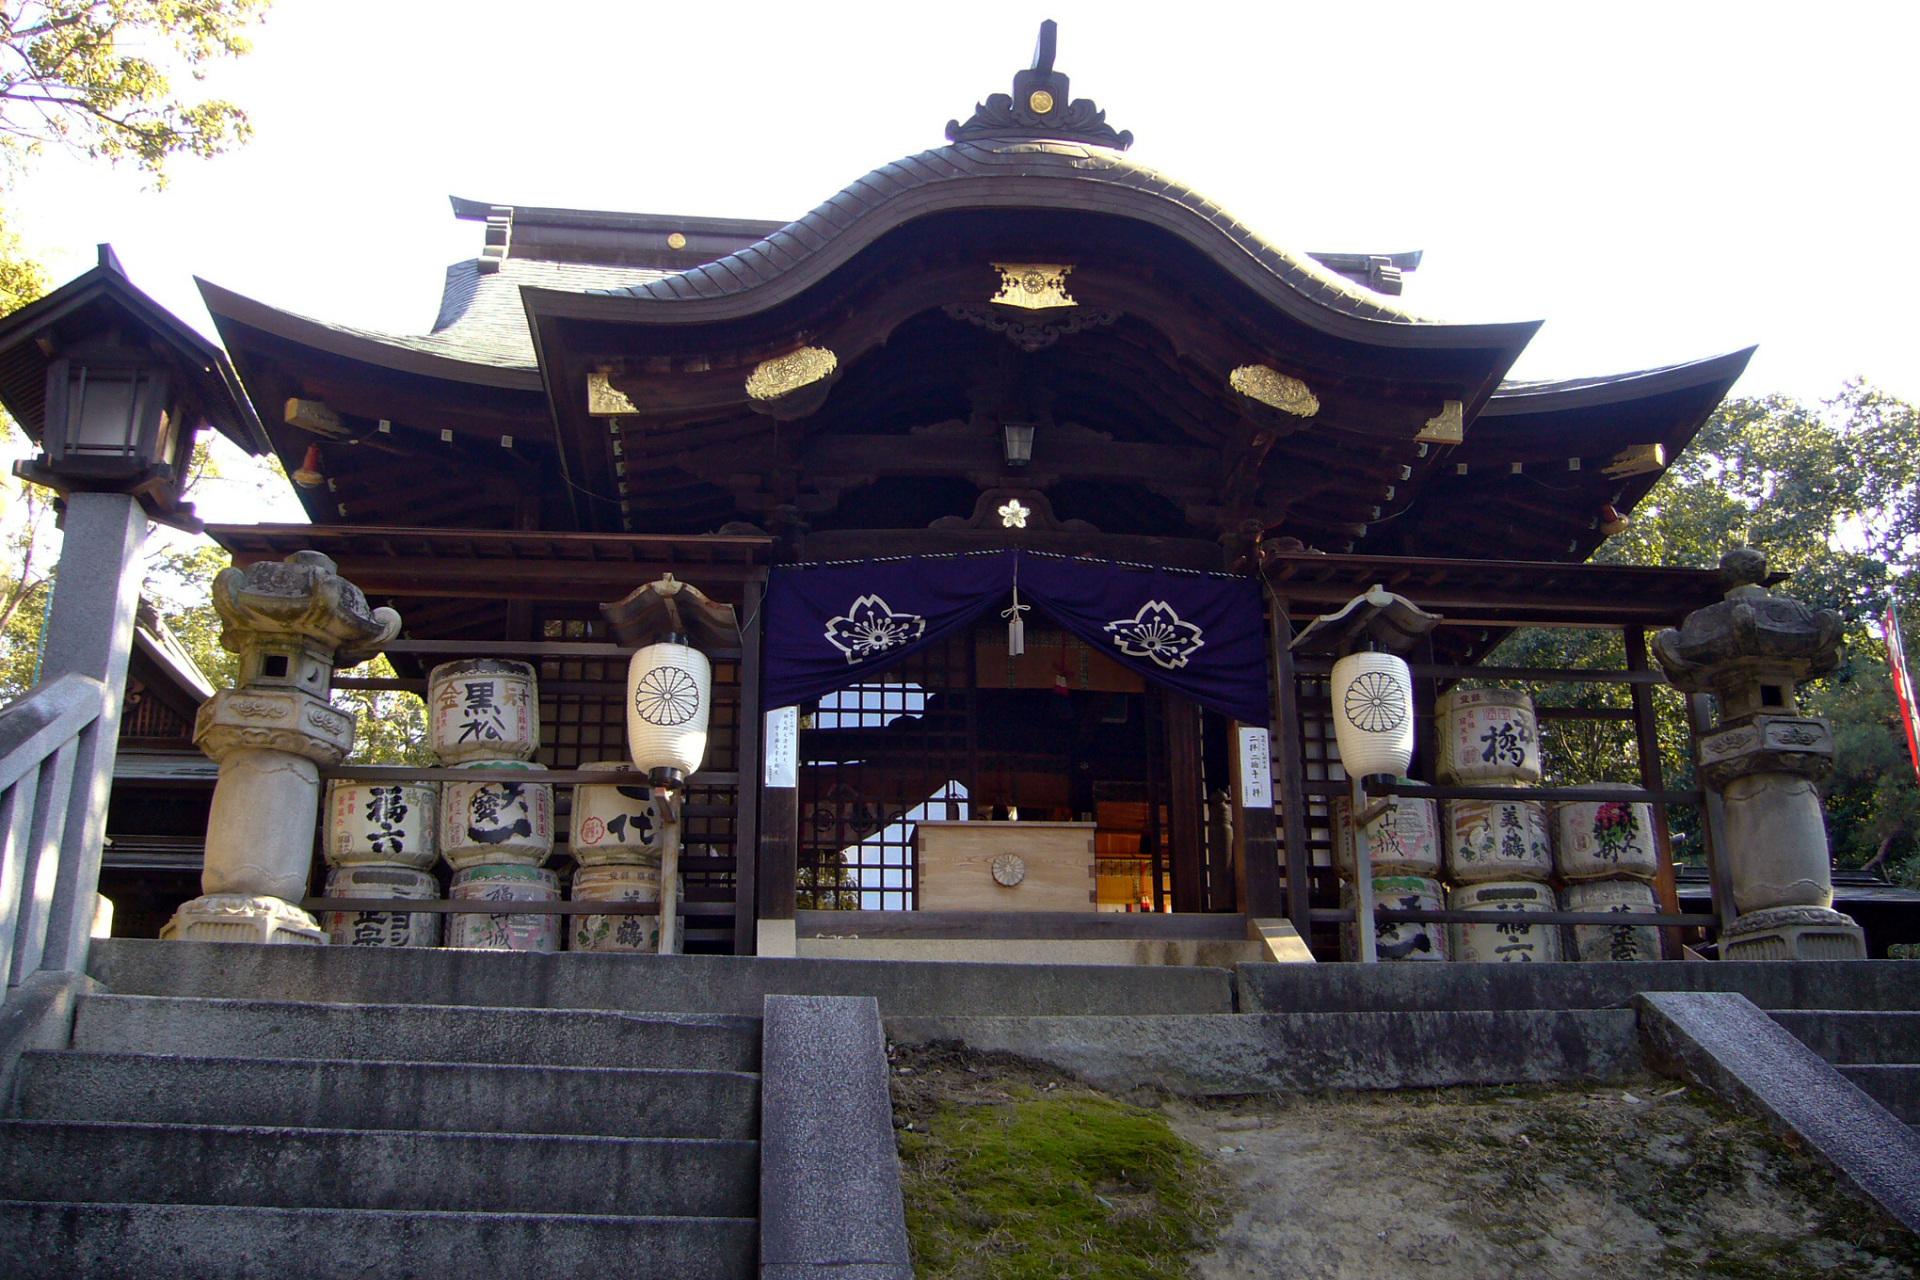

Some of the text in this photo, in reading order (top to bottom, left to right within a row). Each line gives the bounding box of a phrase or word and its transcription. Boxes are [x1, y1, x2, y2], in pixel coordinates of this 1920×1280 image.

[436, 681, 462, 711] 金
[459, 682, 505, 744] 黒松
[366, 786, 408, 853] 福六
[1500, 804, 1526, 859] 美の鶴
